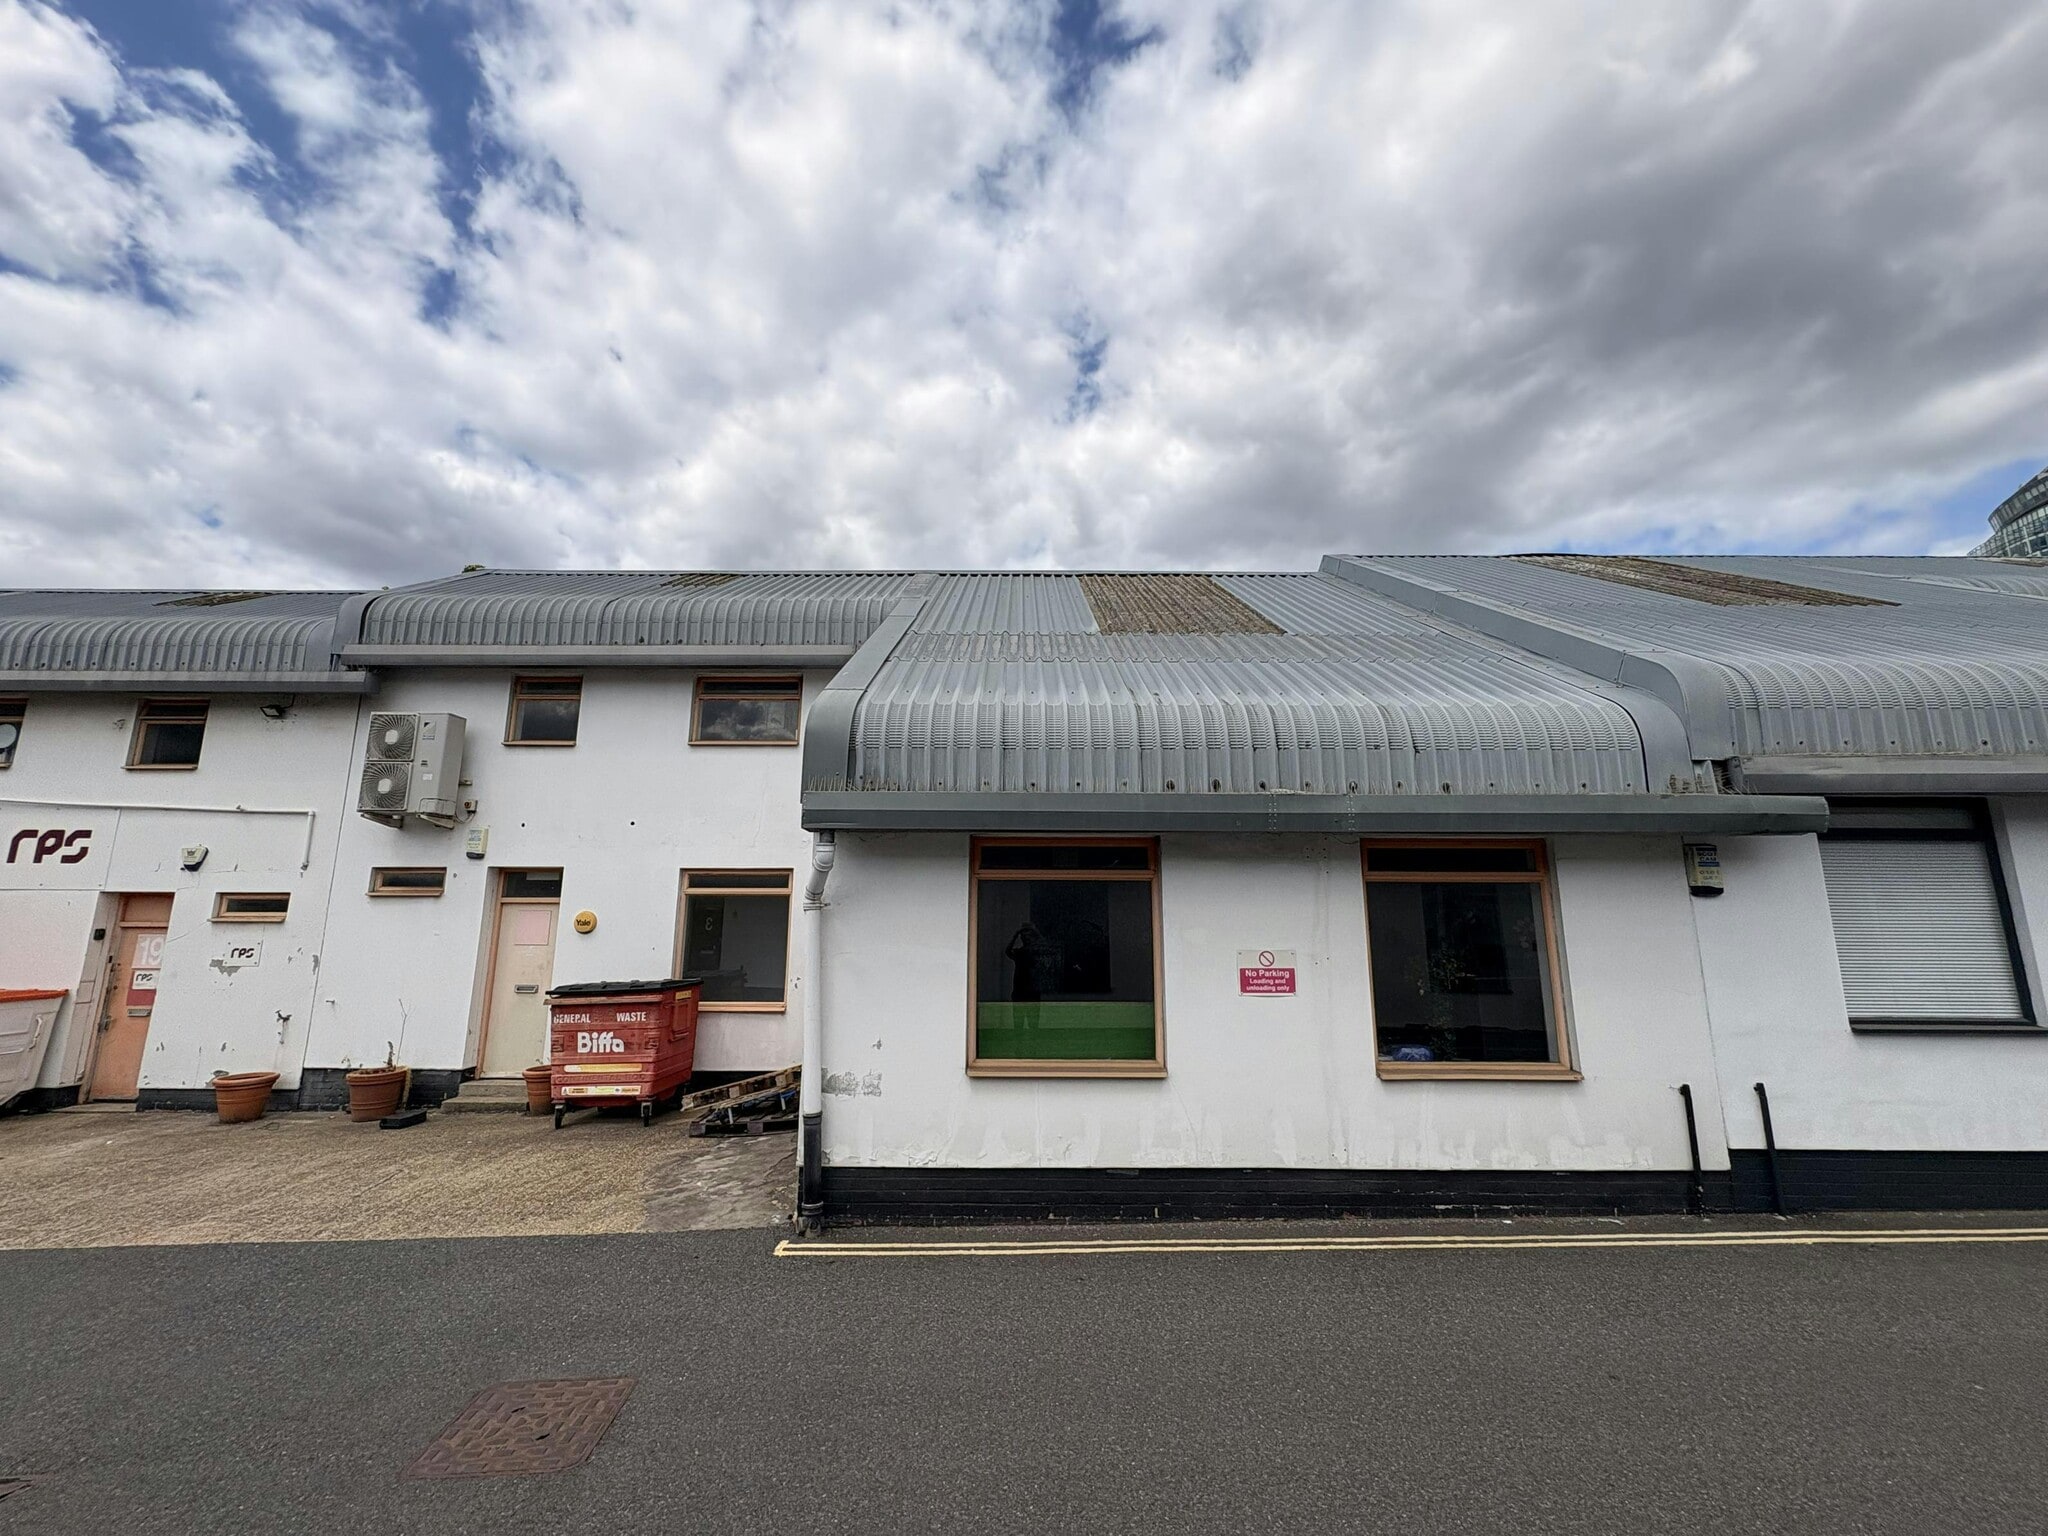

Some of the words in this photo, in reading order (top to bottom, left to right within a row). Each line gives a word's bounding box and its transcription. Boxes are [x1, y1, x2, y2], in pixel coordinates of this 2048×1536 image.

[6, 829, 93, 864] rps
[575, 918, 592, 927] Yale
[140, 936, 165, 966] 19
[230, 947, 255, 959] rps
[135, 973, 153, 982] rps
[1245, 969, 1257, 977] No
[1259, 969, 1290, 978] Parking
[553, 1013, 591, 1024] GENERAL
[616, 1011, 647, 1022] WASTE
[577, 1032, 624, 1053] Biffa
